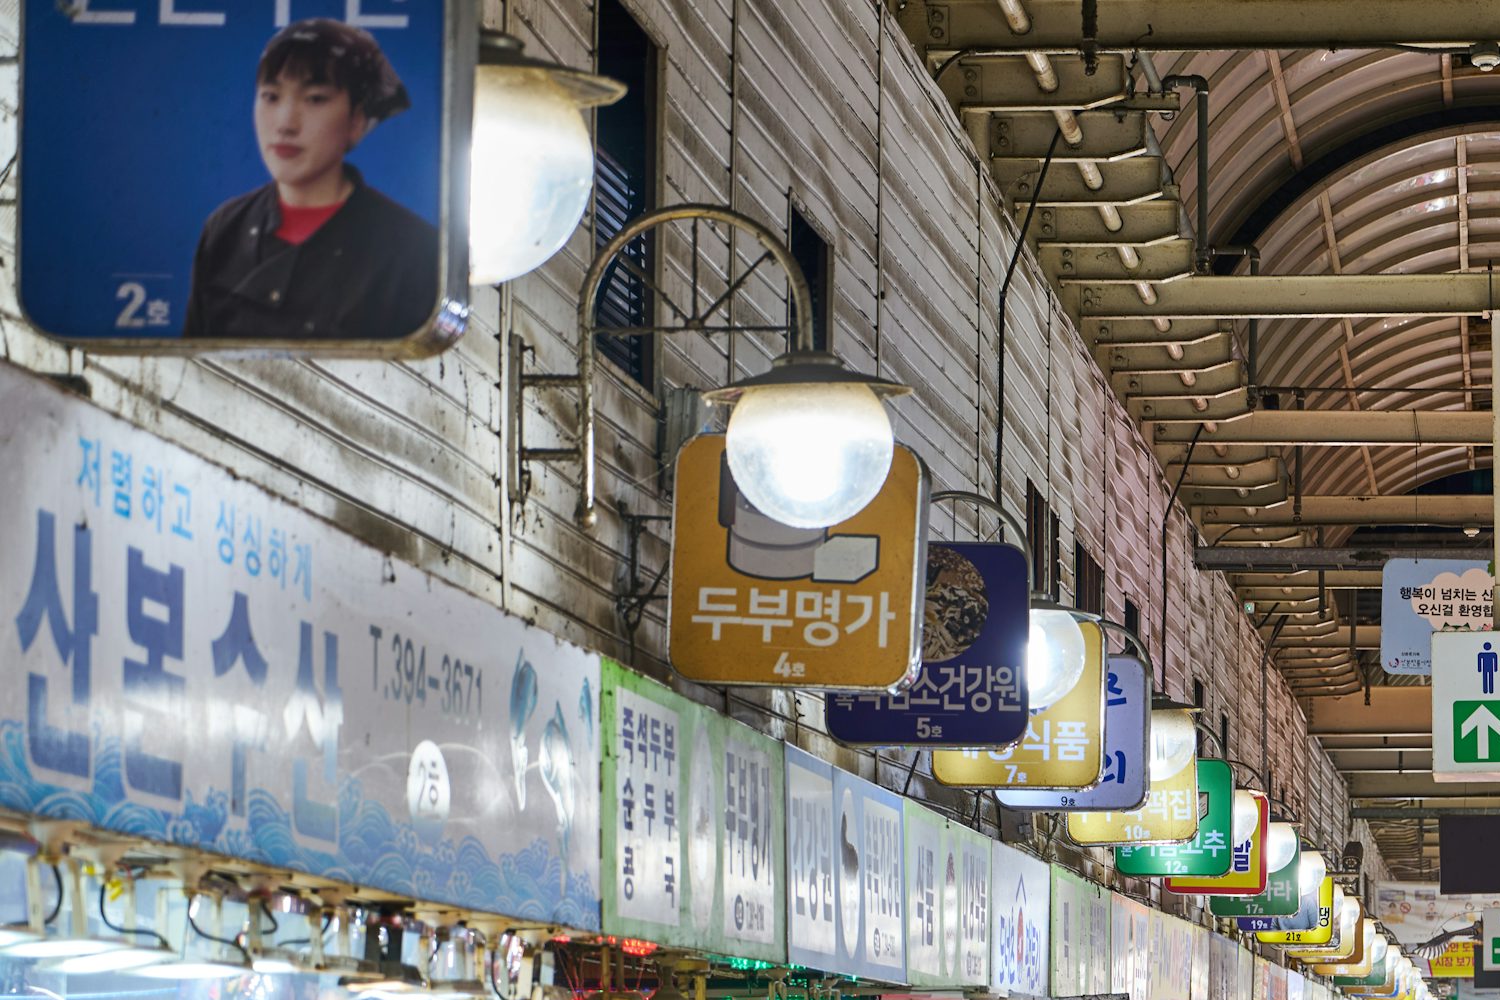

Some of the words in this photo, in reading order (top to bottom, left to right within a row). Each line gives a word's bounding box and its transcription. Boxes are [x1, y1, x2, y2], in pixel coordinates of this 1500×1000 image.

[116, 281, 170, 328] 2호
[77, 438, 194, 540] 저렴하고
[215, 499, 313, 601] 싱싱하게
[1400, 587, 1435, 600] 행복이
[1441, 588, 1476, 601] 넘치는
[691, 586, 896, 648] 두부명가
[1418, 604, 1453, 616] 오신걸
[773, 652, 806, 679] 4호
[14, 507, 345, 853] 산본수산
[917, 718, 942, 738] 5호
[1005, 765, 1027, 783] 7호
[1060, 796, 1076, 807] 9호
[1165, 861, 1188, 873] 12호
[1246, 905, 1263, 914] 17호
[1251, 920, 1268, 929] 19호
[1286, 933, 1301, 941] 21호
